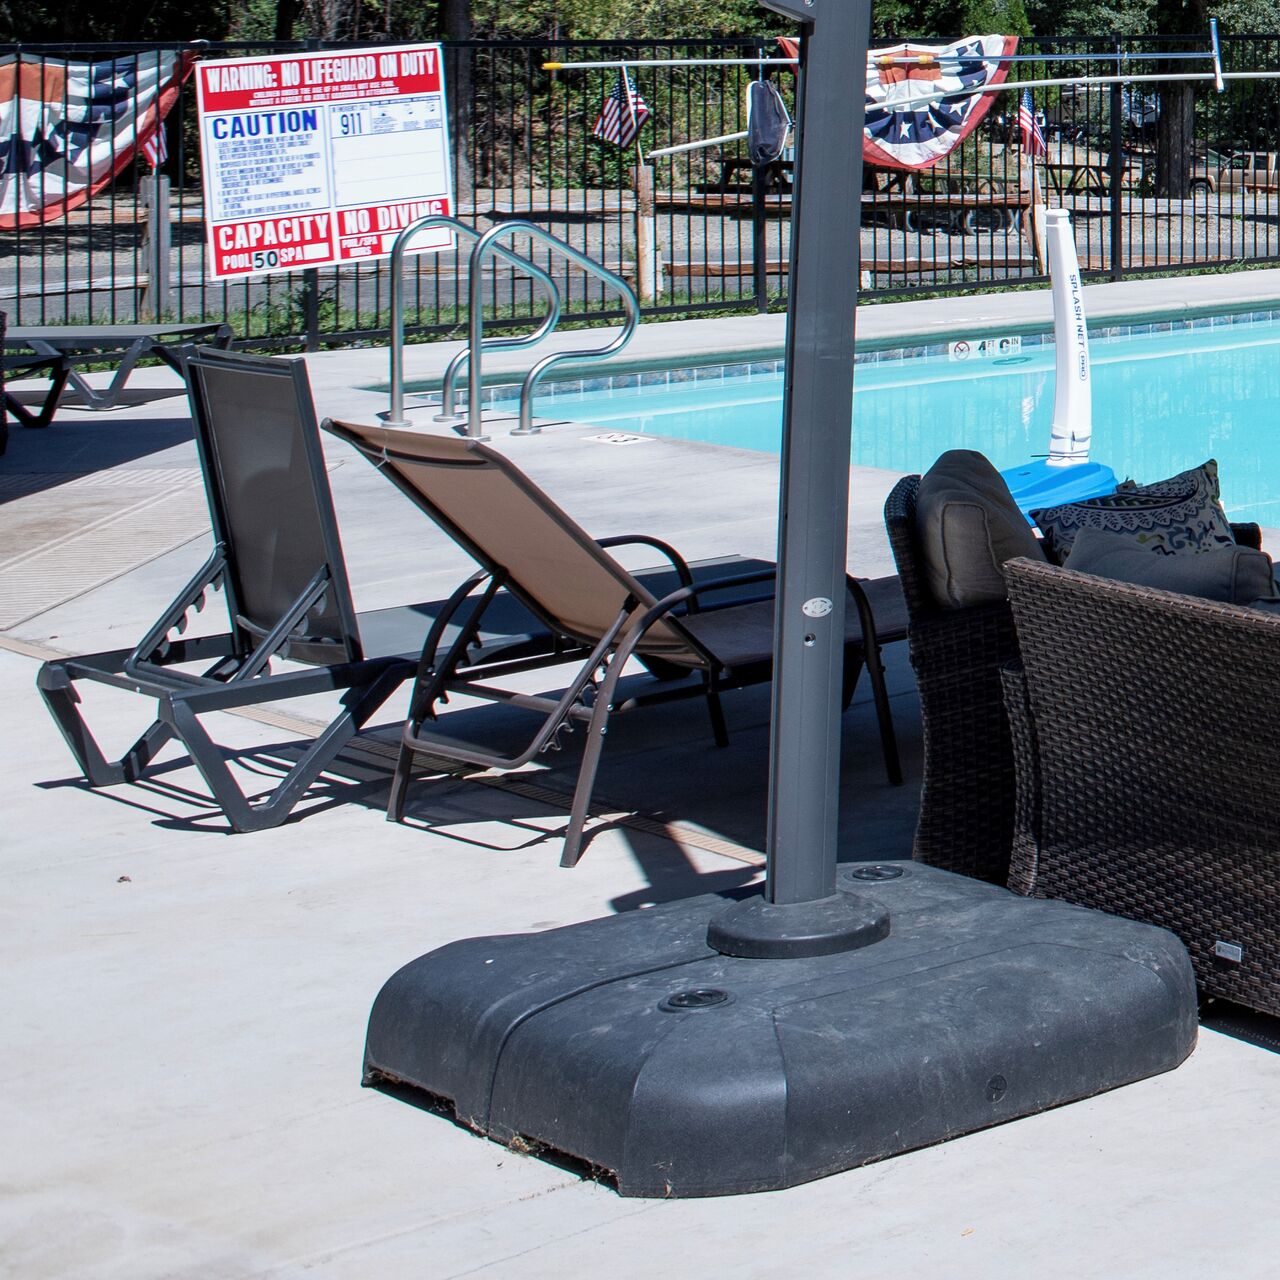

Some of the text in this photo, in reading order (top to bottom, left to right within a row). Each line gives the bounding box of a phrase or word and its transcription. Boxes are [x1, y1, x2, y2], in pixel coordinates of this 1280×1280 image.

[206, 51, 434, 92] WARNING: NO LIFEGUARD ON DUTY
[213, 109, 317, 139] CAUTION
[341, 112, 362, 135] 911
[219, 214, 328, 250] CAPACITY
[344, 201, 442, 235] NO DIVING
[222, 246, 304, 270] POOL 50 SPA
[1070, 274, 1082, 321] SPLASH
[1076, 325, 1084, 349] NET
